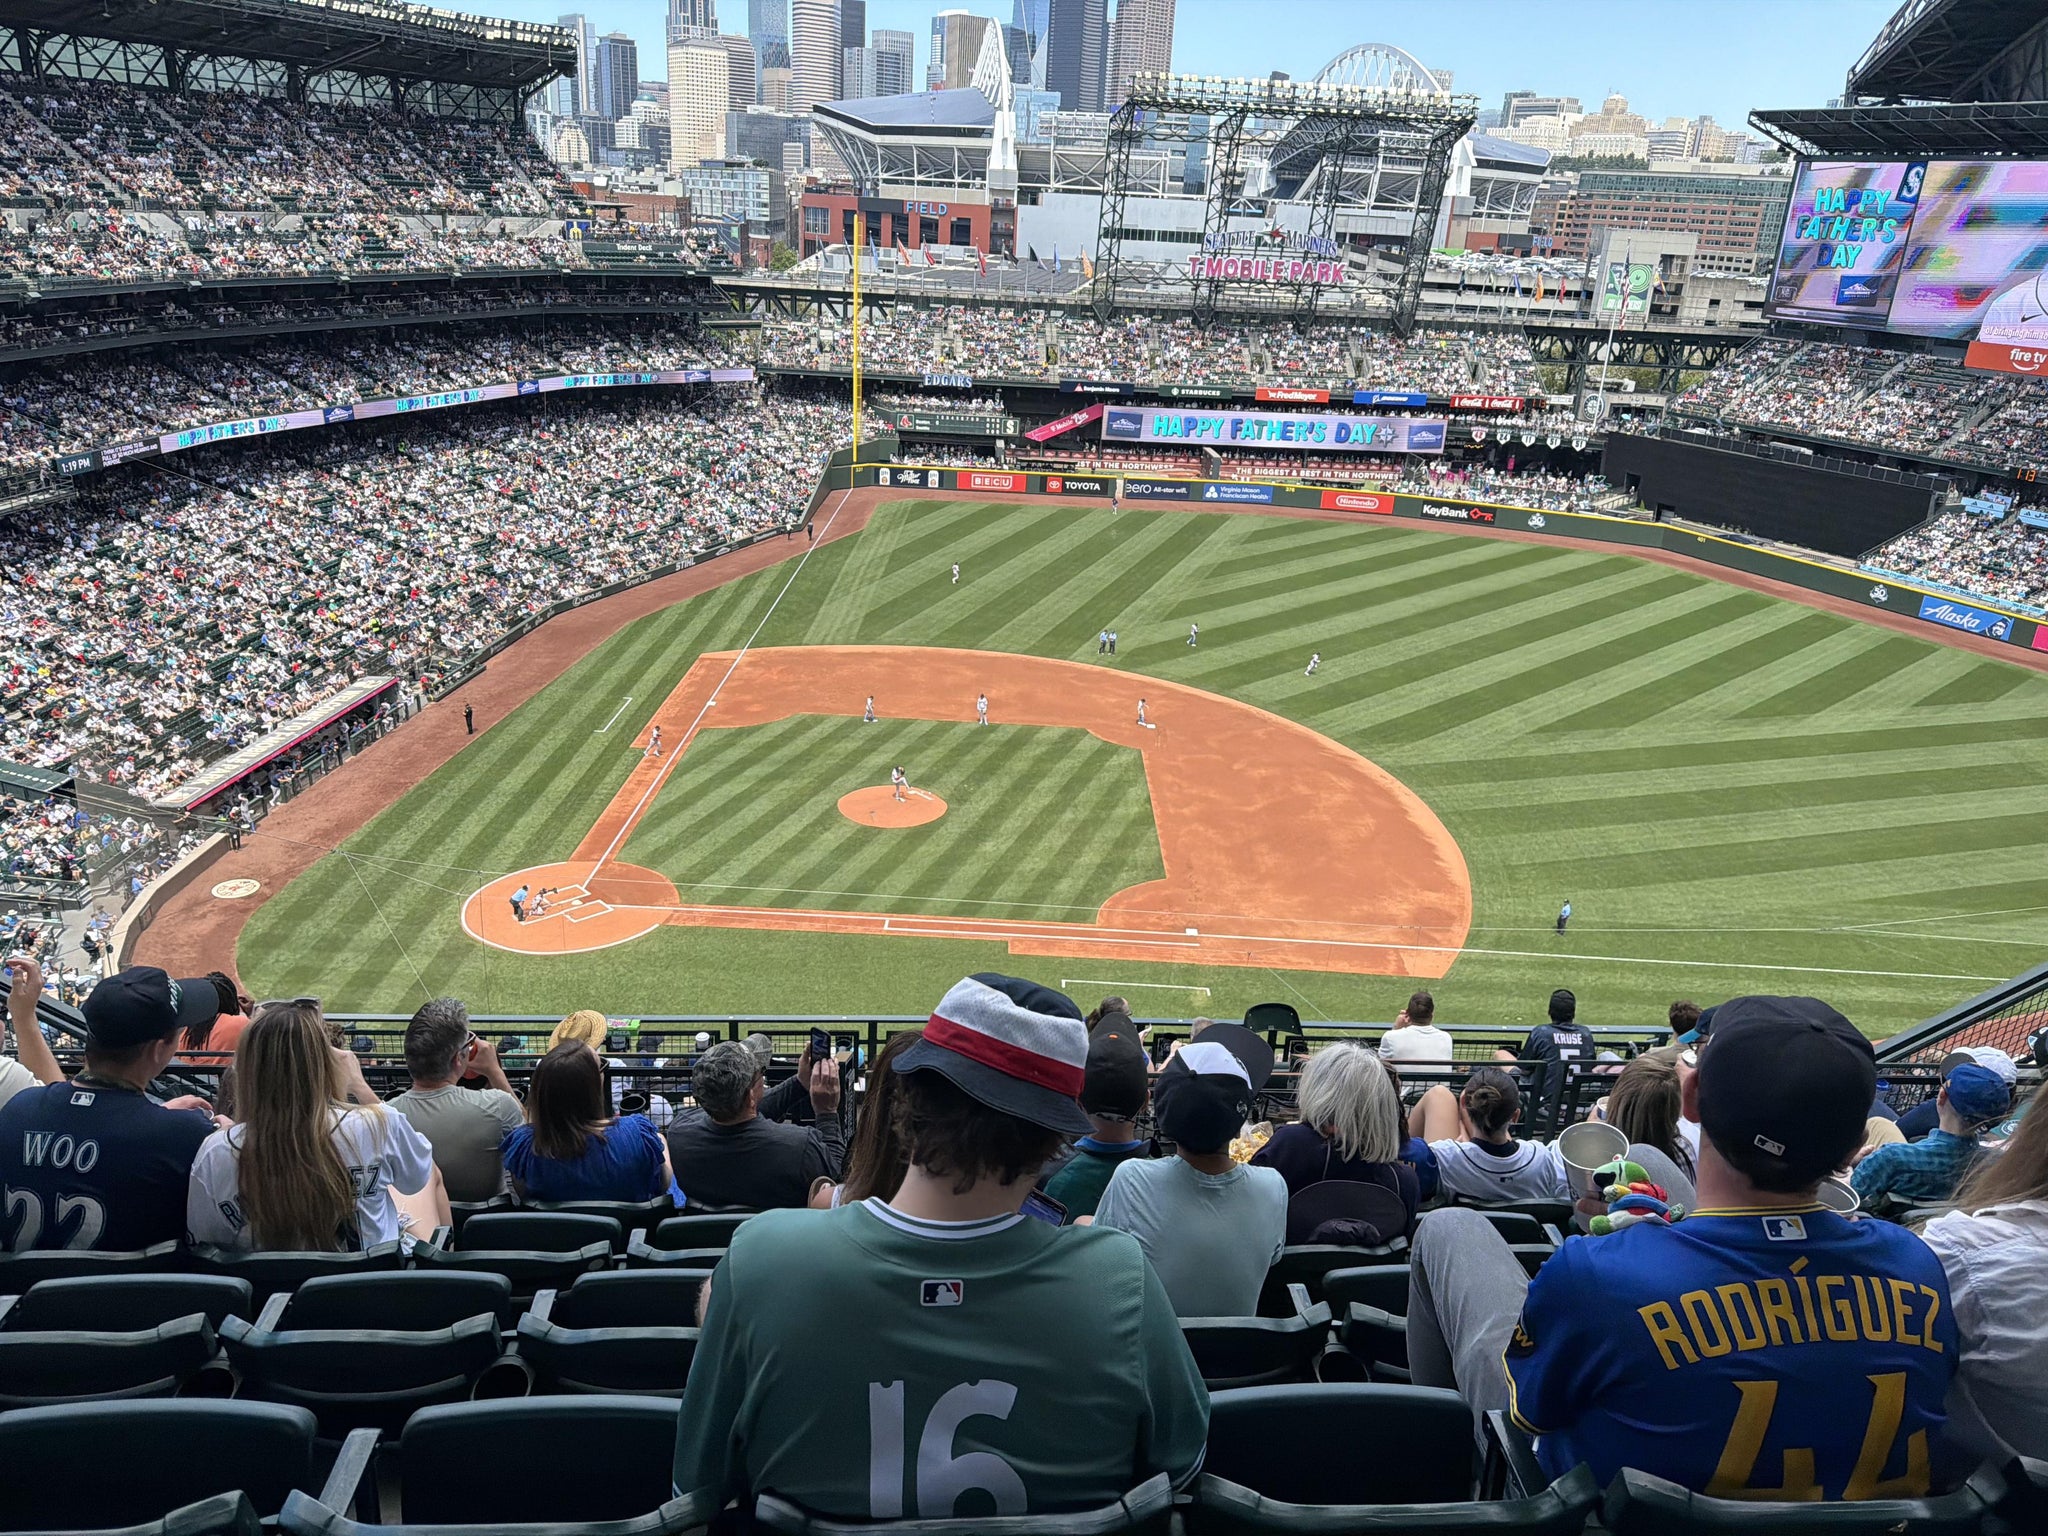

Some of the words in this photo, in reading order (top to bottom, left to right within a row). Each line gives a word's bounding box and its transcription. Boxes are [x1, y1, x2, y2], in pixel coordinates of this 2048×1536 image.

[906, 201, 948, 216] FIELD
[1814, 187, 1892, 215] HAPPY
[1796, 215, 1898, 244] FATHER'S
[1204, 230, 1256, 250] SEATTLE
[1287, 230, 1338, 257] MARINERS
[1815, 244, 1862, 270] DAY
[1187, 255, 1285, 280] T-MOBILE
[1289, 260, 1348, 283] PARK
[1993, 327, 2023, 340] bringing
[2023, 329, 2039, 339] him
[2010, 348, 2032, 362] fire
[2034, 351, 2047, 364] tv
[563, 377, 590, 387] HAPPY
[593, 374, 632, 385] FATHER'S
[635, 373, 651, 383] DAY
[924, 374, 973, 389] EDGARS
[1181, 388, 1221, 397] STARBUCKS
[396, 398, 424, 411] HAPPY
[426, 393, 462, 407] FATHER'S
[464, 390, 479, 402] DAY
[178, 428, 207, 448] HAPPY
[208, 421, 255, 440] FATHER'S
[258, 417, 279, 432] DAY
[1152, 414, 1225, 439] HAPPY
[1231, 417, 1328, 443] FATHER'S
[1334, 422, 1378, 440] DAY
[61, 461, 77, 474] 1:19
[78, 457, 91, 470] PM
[1103, 461, 1119, 469] THE
[1236, 467, 1252, 475] THE
[1254, 468, 1290, 476] BIGGEST
[1323, 470, 1332, 478] IN
[1333, 471, 1350, 479] THE
[974, 477, 1010, 487] BECU
[1065, 481, 1101, 491] TOYOTA
[1153, 486, 1175, 494] All-star
[1220, 486, 1241, 494] Virginia
[1251, 493, 1270, 501] Health
[1340, 497, 1375, 506] Nintendo
[1422, 504, 1469, 519] KeyBank
[675, 558, 696, 571] STIHL
[625, 577, 640, 587] Great
[1873, 588, 1886, 596] 50
[1924, 604, 1980, 629] Alaska
[1553, 1032, 1583, 1045] KRUSE
[22, 1130, 100, 1173] WOO
[4, 1183, 107, 1250] 22
[1637, 1255, 1944, 1370] RODRÍGUEZ
[1703, 1371, 1930, 1502] 44
[869, 1379, 1028, 1519] 16
